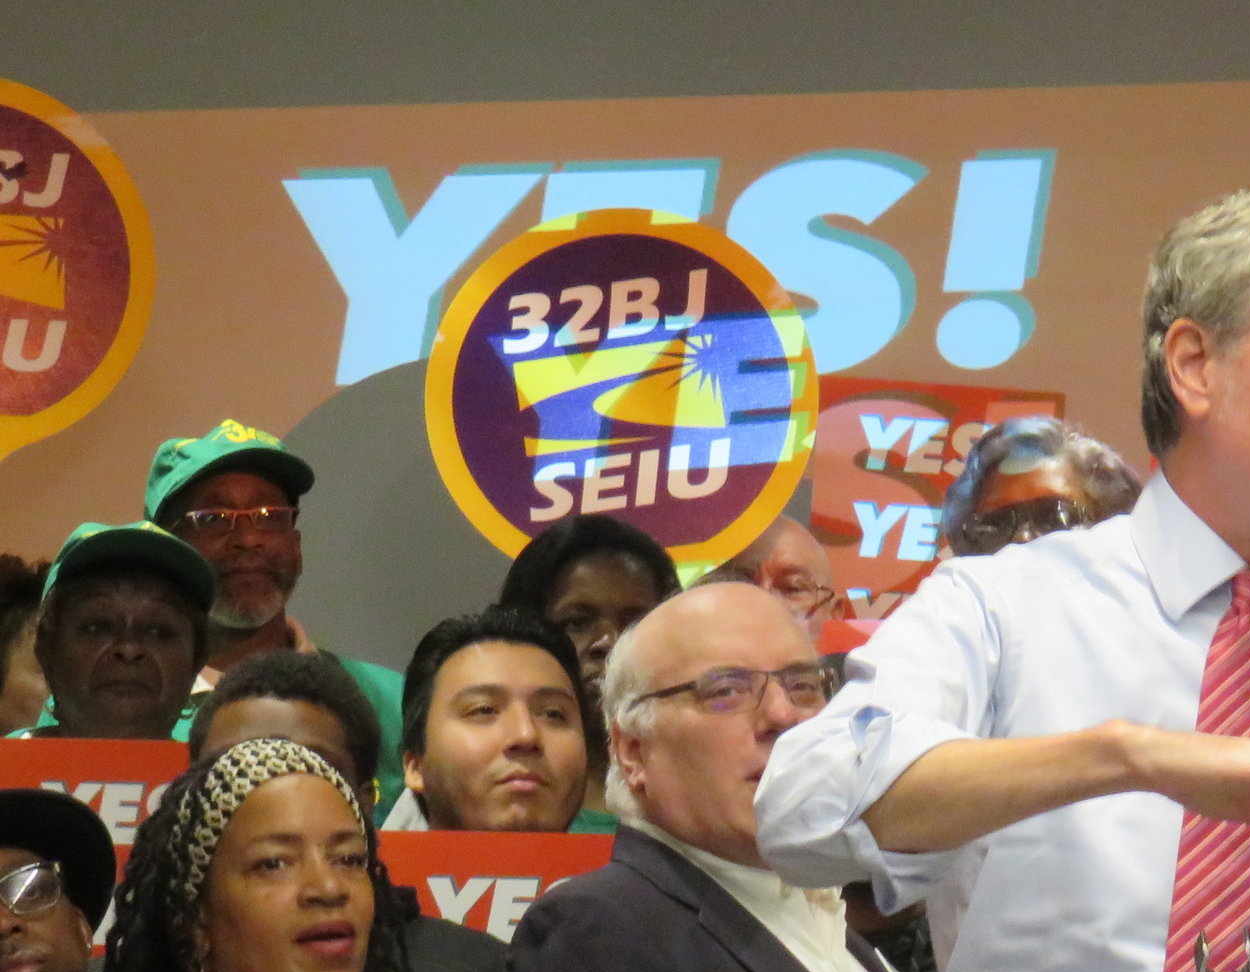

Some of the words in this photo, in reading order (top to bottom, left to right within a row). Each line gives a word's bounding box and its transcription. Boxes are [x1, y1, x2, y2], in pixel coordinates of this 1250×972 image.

[503, 268, 708, 355] 32BJ
[530, 437, 731, 522] SEIU
[426, 875, 573, 945] YE
